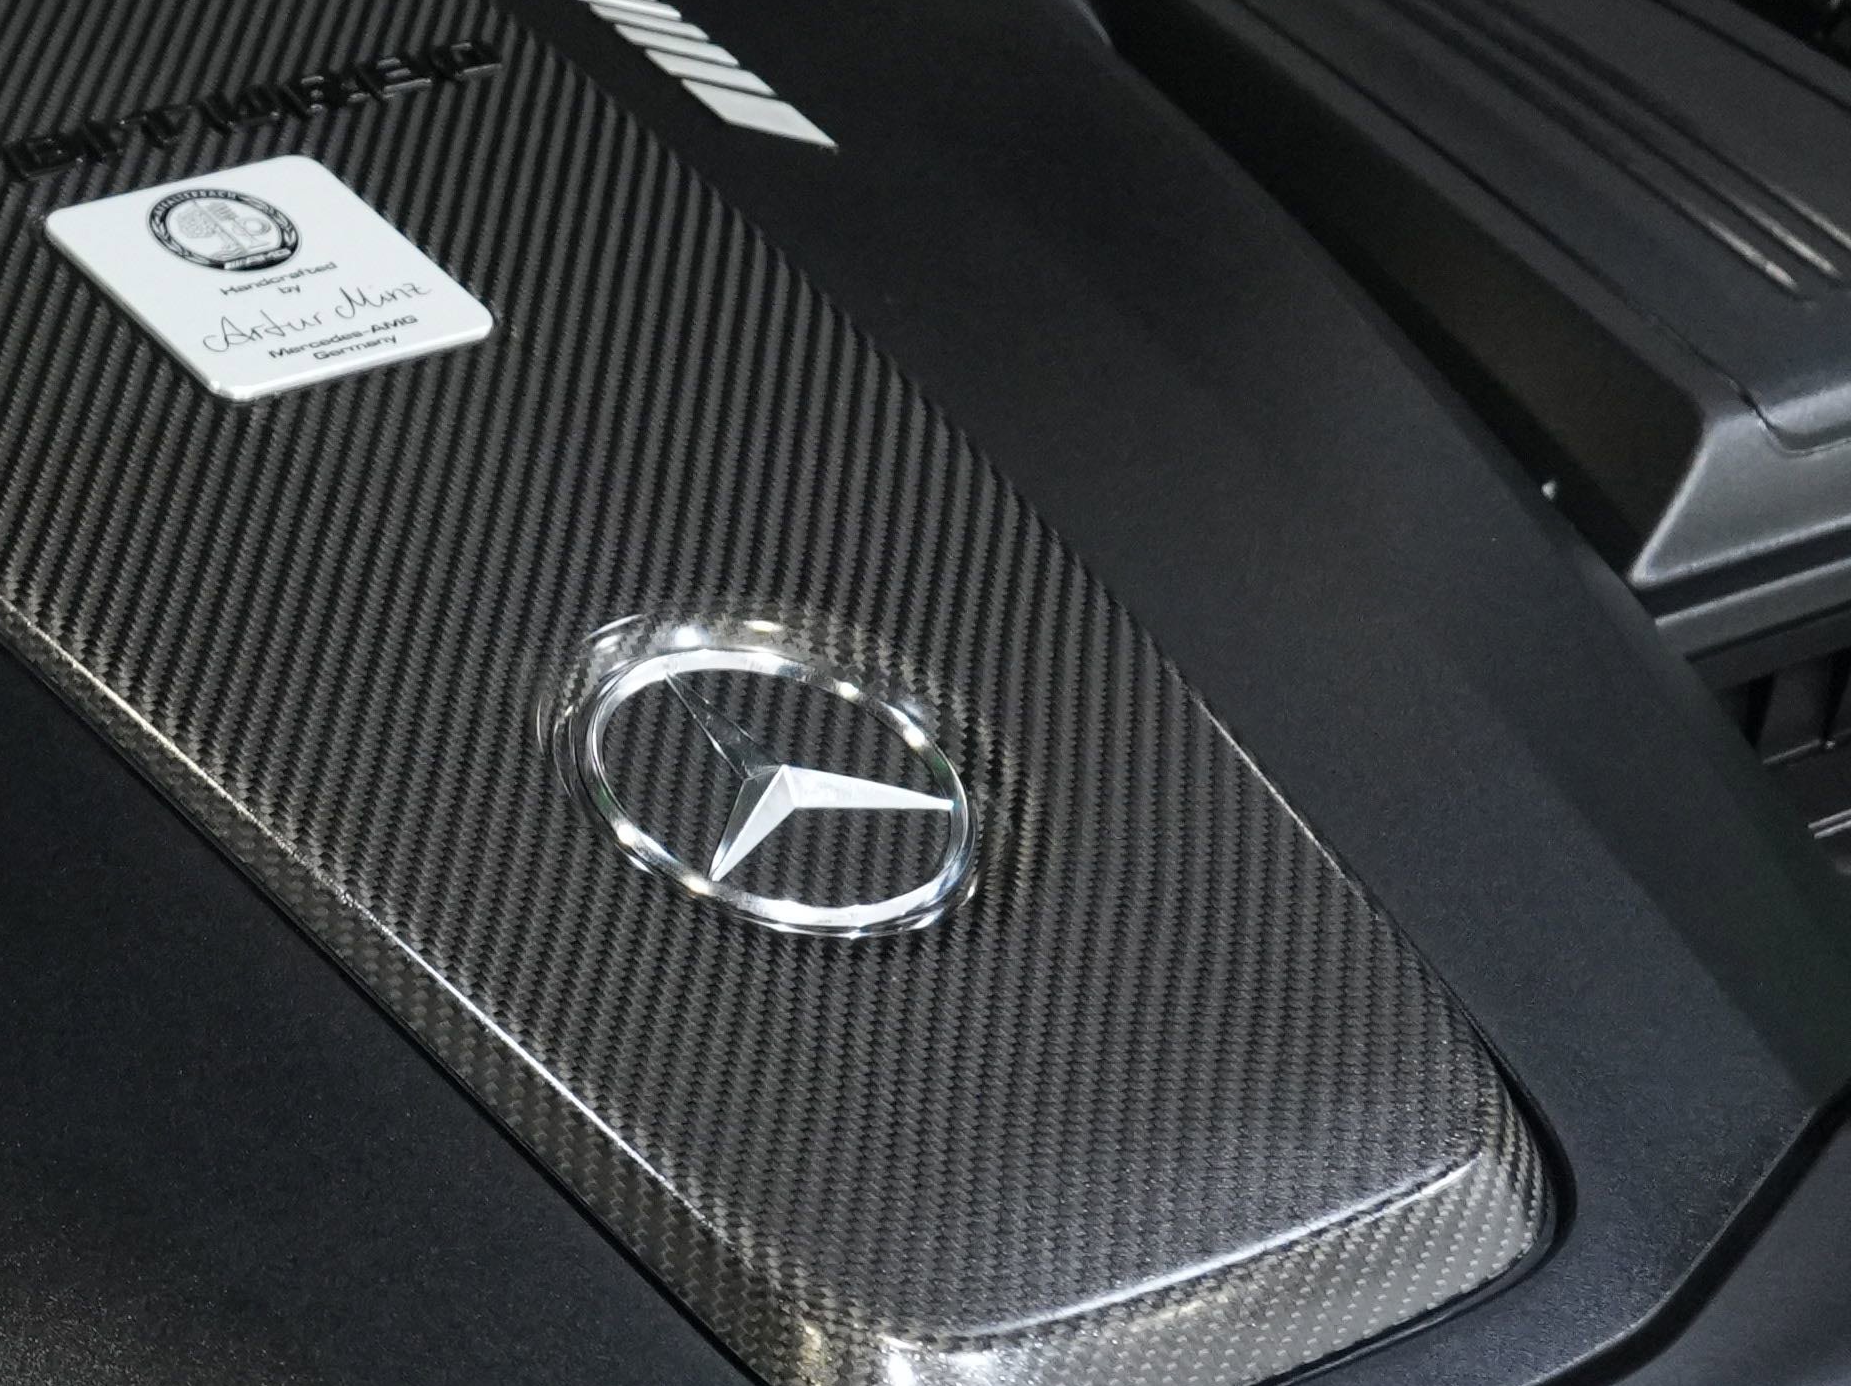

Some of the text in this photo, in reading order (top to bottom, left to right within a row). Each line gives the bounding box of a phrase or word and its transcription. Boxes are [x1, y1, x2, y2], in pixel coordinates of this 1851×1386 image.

[220, 261, 338, 295] Handcrafted
[278, 284, 301, 295] by
[202, 309, 323, 353] Artur
[268, 314, 419, 359] Mercedes-AMG
[312, 335, 399, 361] Germany
